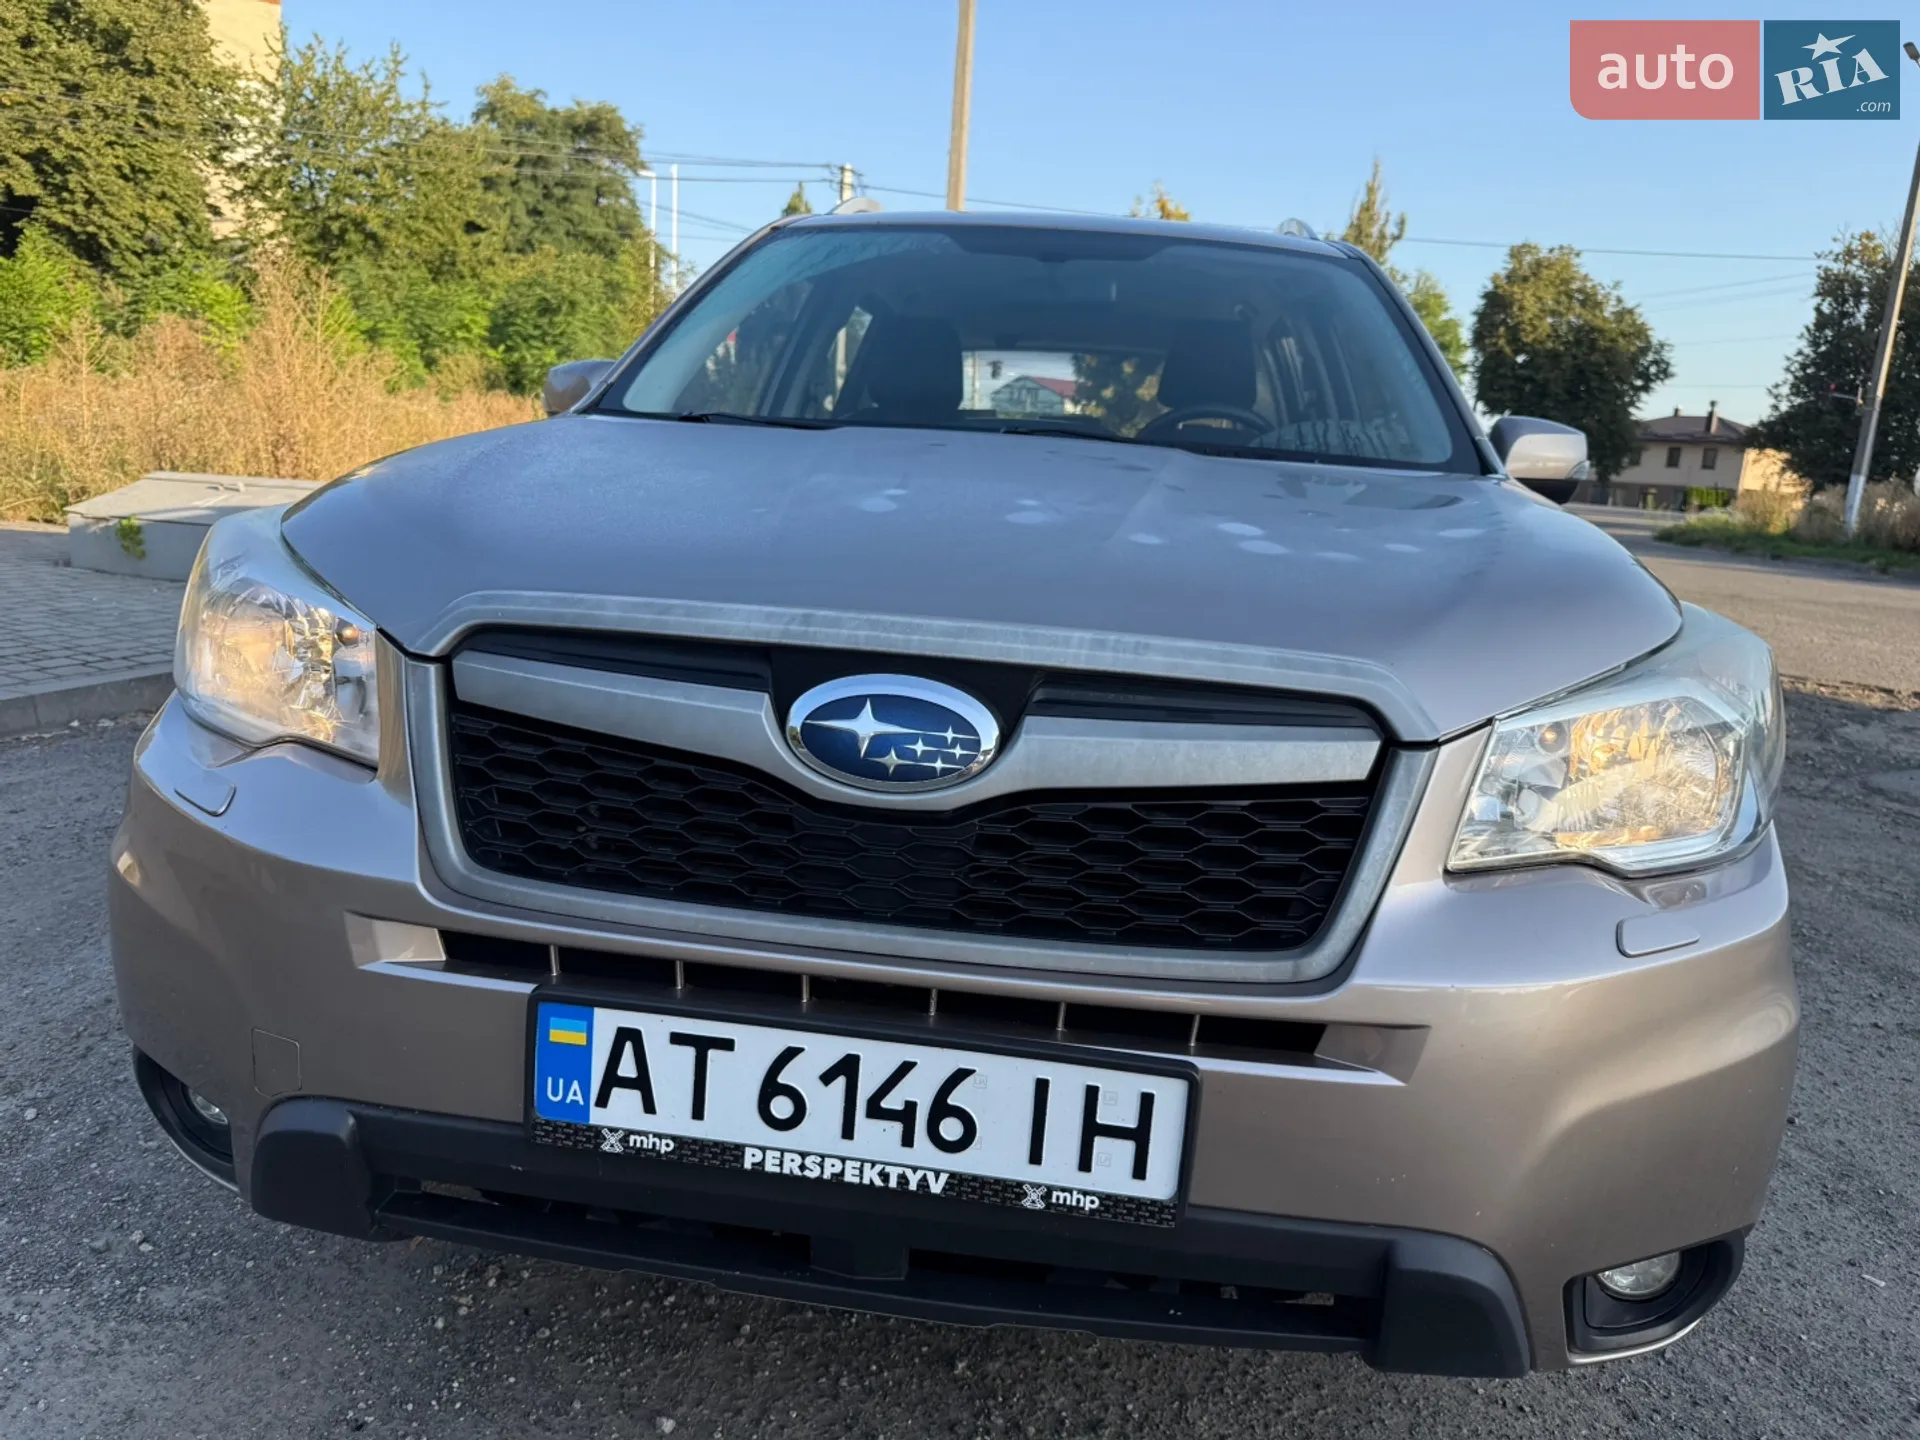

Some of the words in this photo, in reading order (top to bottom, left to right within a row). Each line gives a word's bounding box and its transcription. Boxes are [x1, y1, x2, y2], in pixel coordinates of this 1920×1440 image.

[546, 1077, 585, 1105] UA
[594, 1027, 736, 1121] AT
[757, 1046, 978, 1154] 6146
[1028, 1077, 1155, 1181] IH
[629, 1133, 675, 1154] mhp
[744, 1146, 950, 1194] PERSPEKTYV
[1051, 1190, 1100, 1211] mhp
